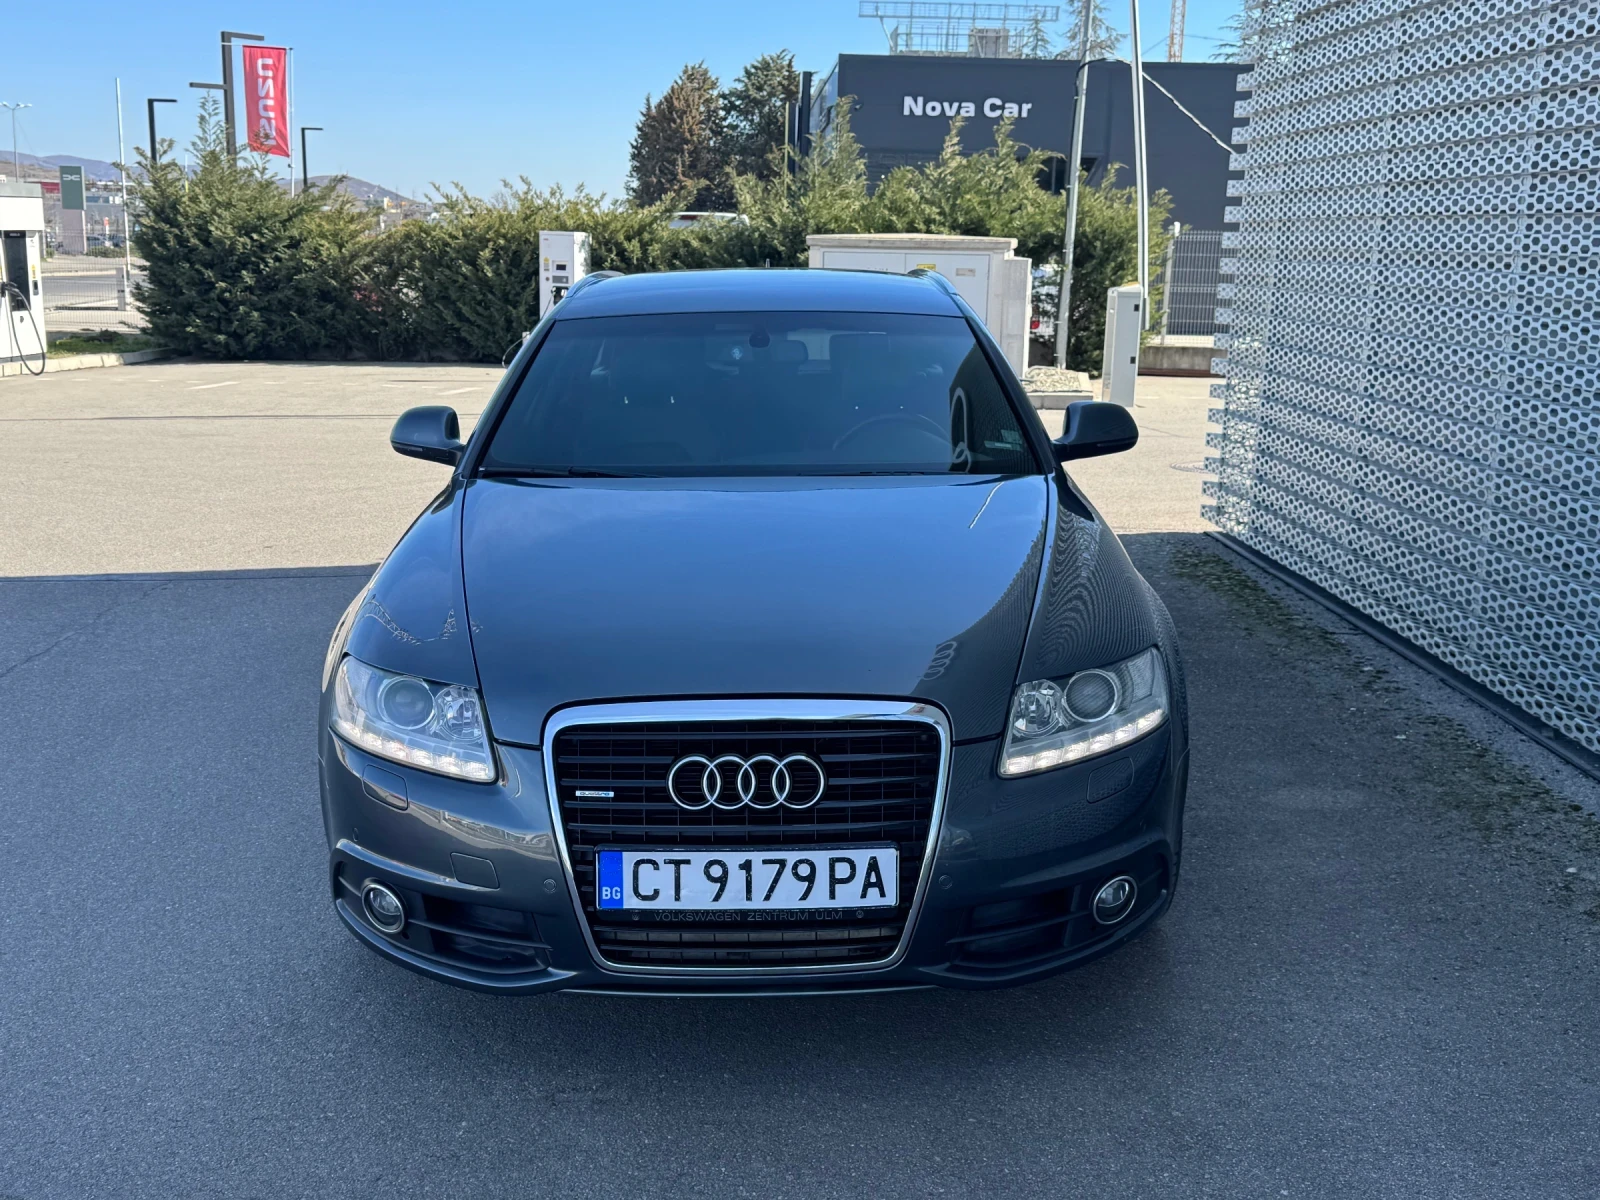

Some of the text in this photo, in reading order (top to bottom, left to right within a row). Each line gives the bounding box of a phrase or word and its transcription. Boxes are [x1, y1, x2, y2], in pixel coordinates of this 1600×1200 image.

[903, 96, 1033, 118] Nova Car
[602, 887, 621, 900] BG
[654, 911, 843, 922] VOLKSWAGEN ZENTRUM ULM
